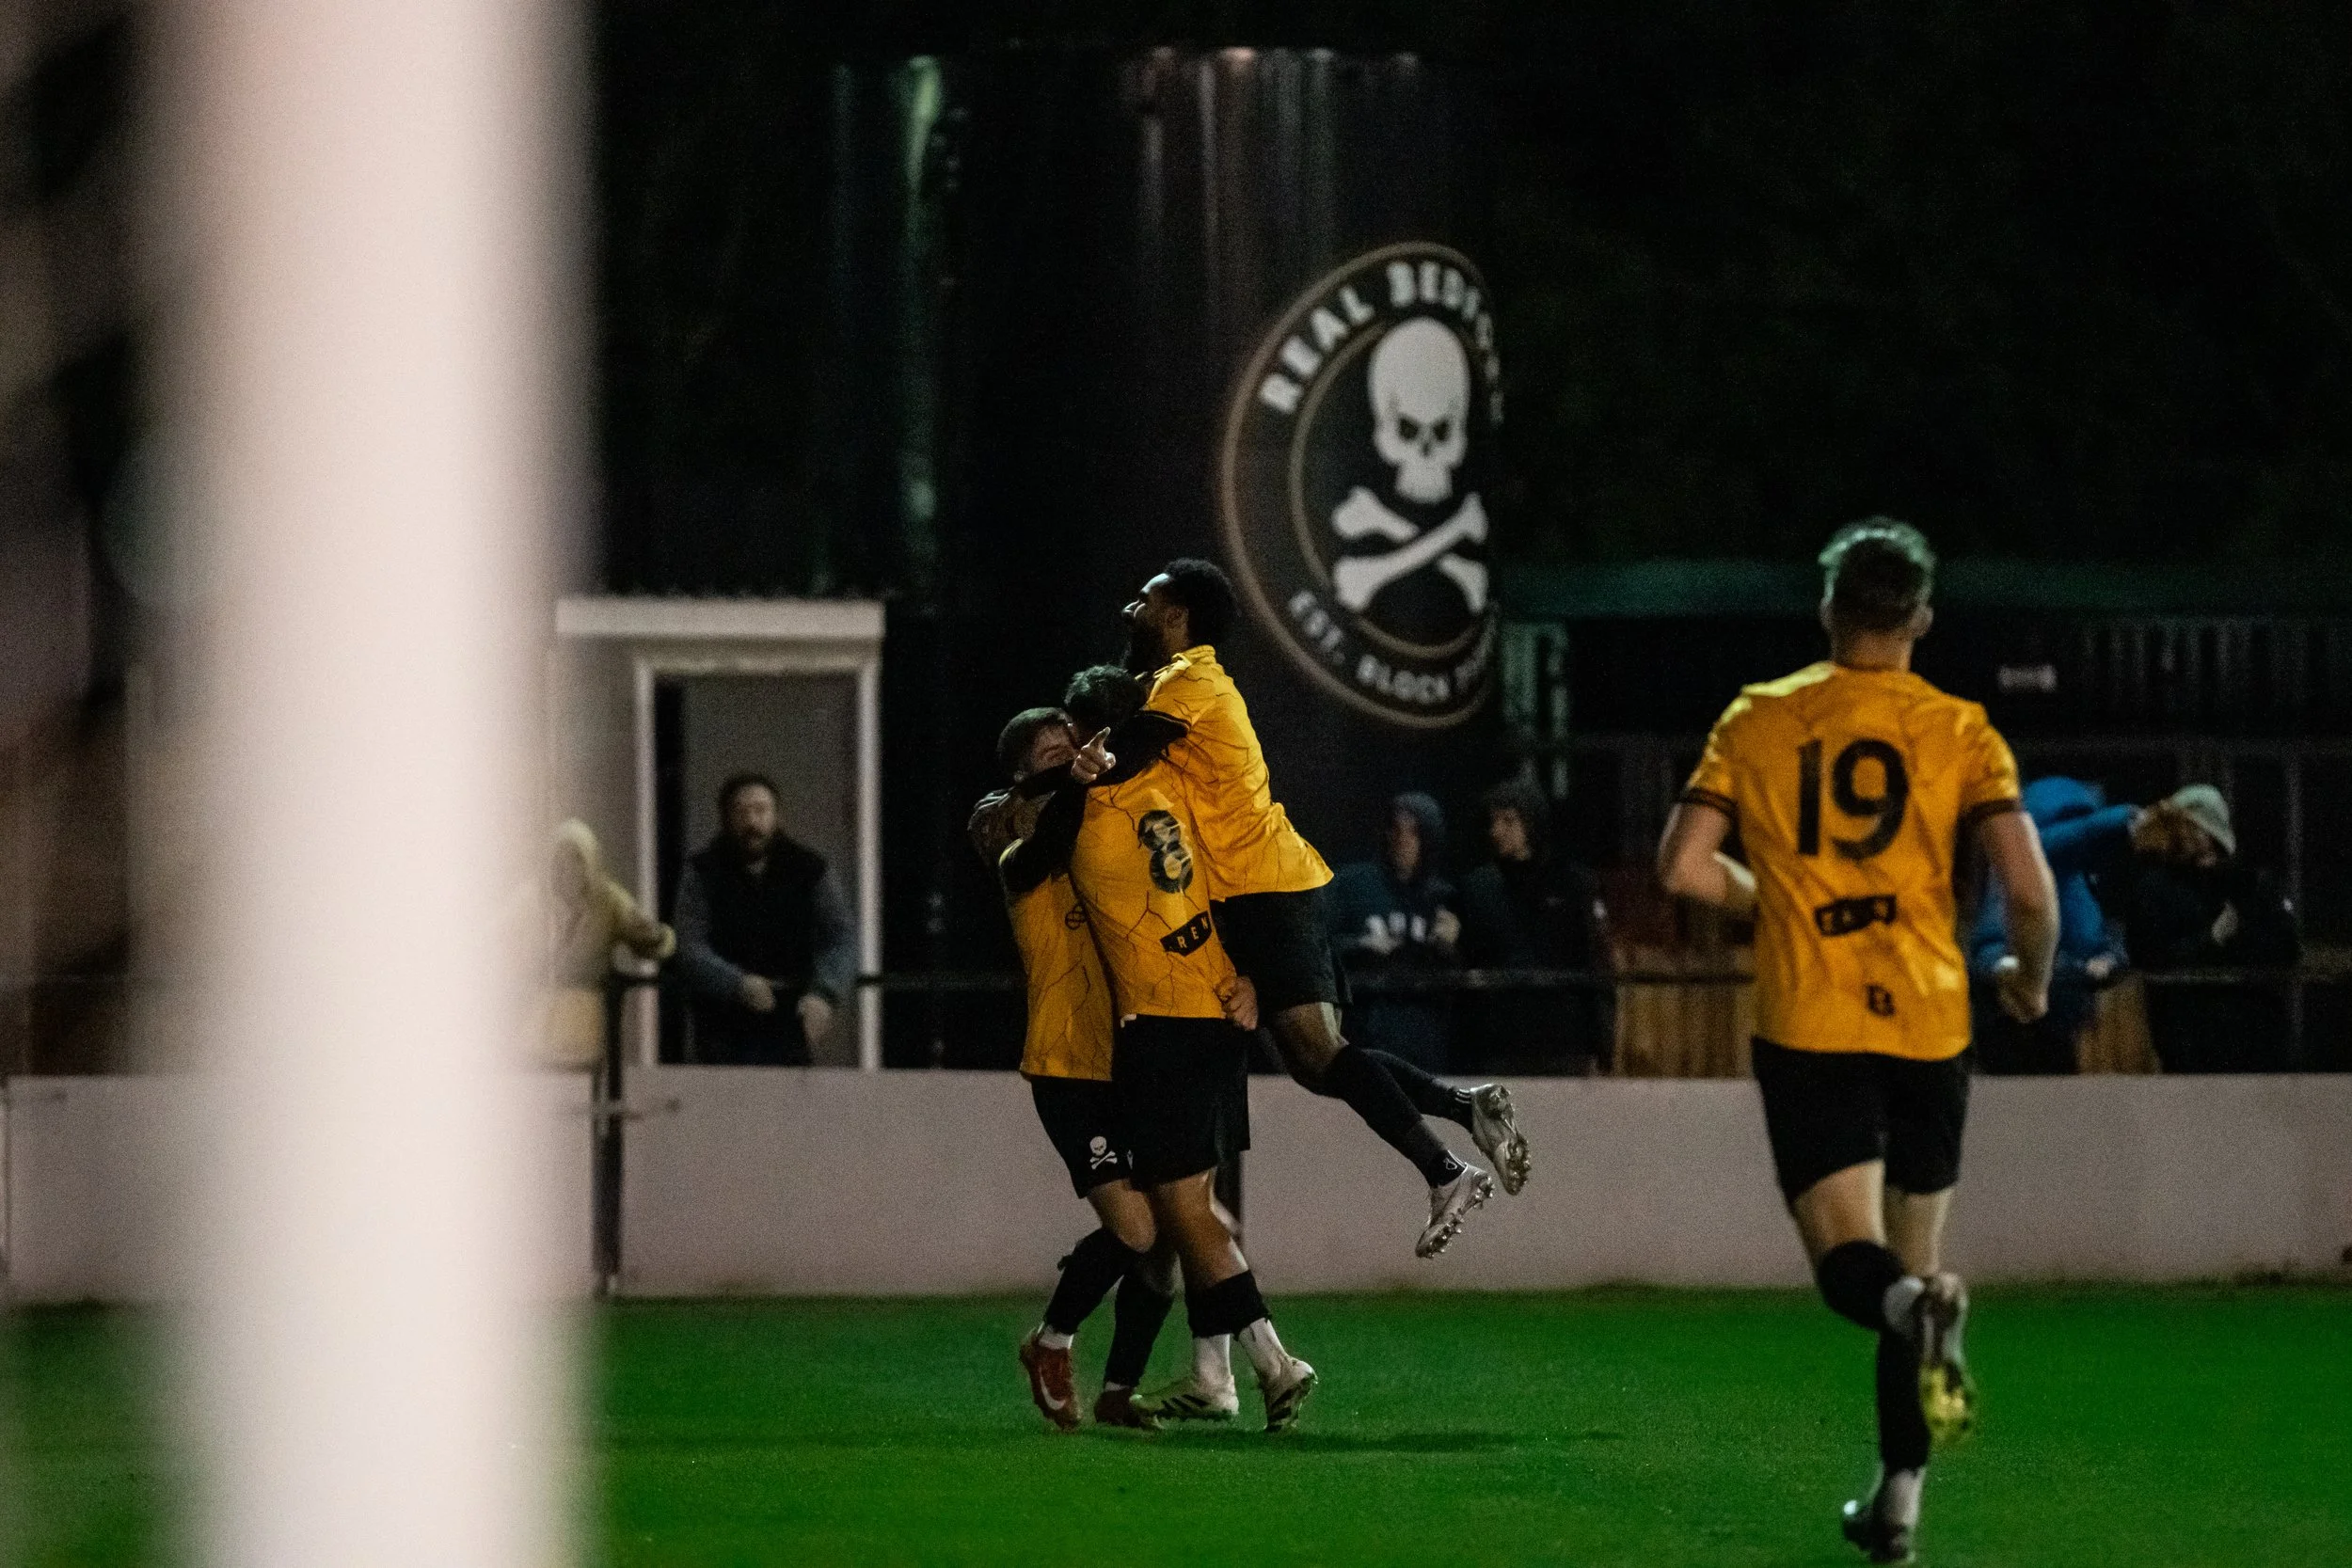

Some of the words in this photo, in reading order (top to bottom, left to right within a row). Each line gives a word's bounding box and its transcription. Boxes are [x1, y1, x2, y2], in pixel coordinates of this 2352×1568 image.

[1259, 284, 1375, 415] REAL
[1138, 810, 1193, 894] 8
[1797, 737, 1909, 861] 19
